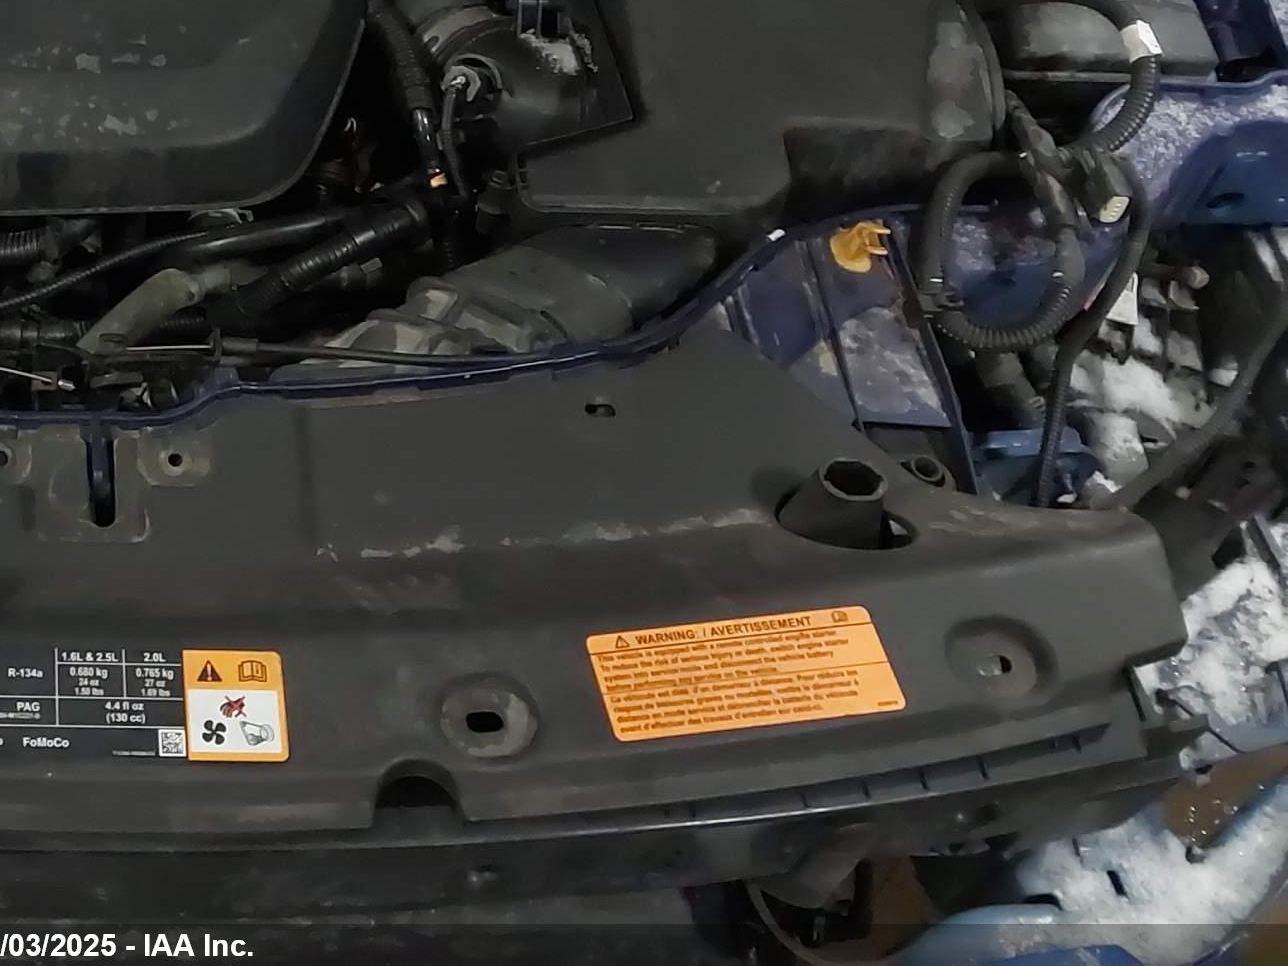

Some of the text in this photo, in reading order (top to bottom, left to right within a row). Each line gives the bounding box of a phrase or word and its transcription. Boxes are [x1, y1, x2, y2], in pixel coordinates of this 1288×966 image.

[635, 629, 695, 645] WARNING
[710, 616, 812, 637] AVERTISSEMENT
[62, 652, 119, 662] 1.6L & 2.5L
[143, 653, 167, 662] 2.0L
[8, 668, 44, 678] R-134a
[96, 668, 108, 679] kg
[136, 668, 174, 680] 0.765 kg
[16, 702, 40, 712] PAG
[104, 701, 144, 711] 4.4 fl oz
[106, 713, 146, 724] (130 cc)
[23, 737, 70, 748] FoMoCo
